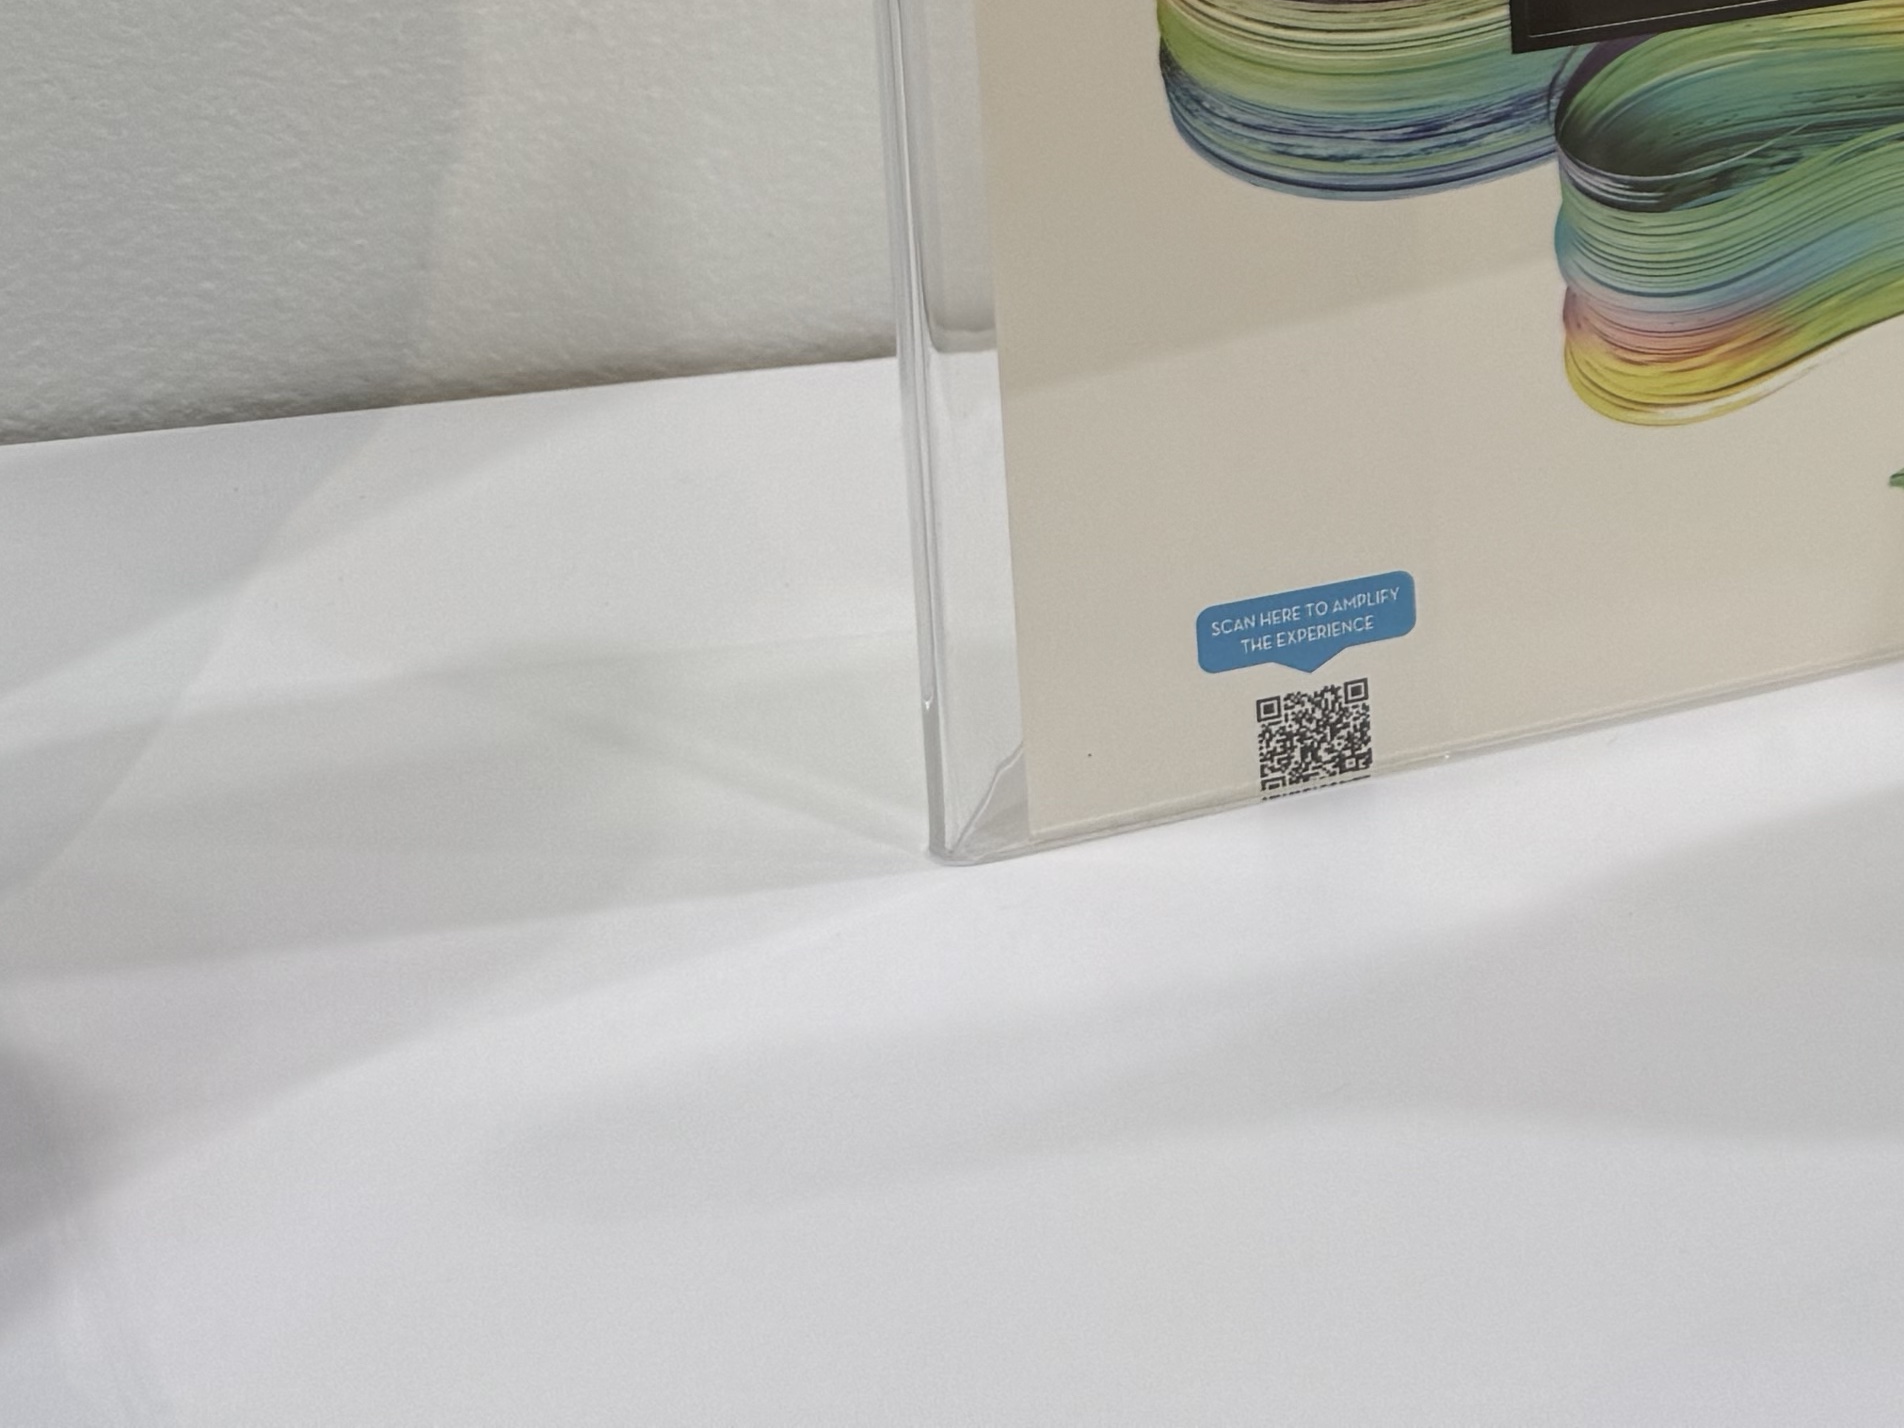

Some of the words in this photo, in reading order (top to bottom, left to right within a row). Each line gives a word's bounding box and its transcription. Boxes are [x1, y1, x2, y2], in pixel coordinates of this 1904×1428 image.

[1211, 613, 1255, 636] SCAN
[1259, 604, 1300, 626] HERE
[1304, 600, 1328, 617] TO
[1332, 586, 1399, 612] AMPLIFY
[1240, 634, 1272, 653] THE
[1276, 614, 1374, 647] EXPERIENCE
